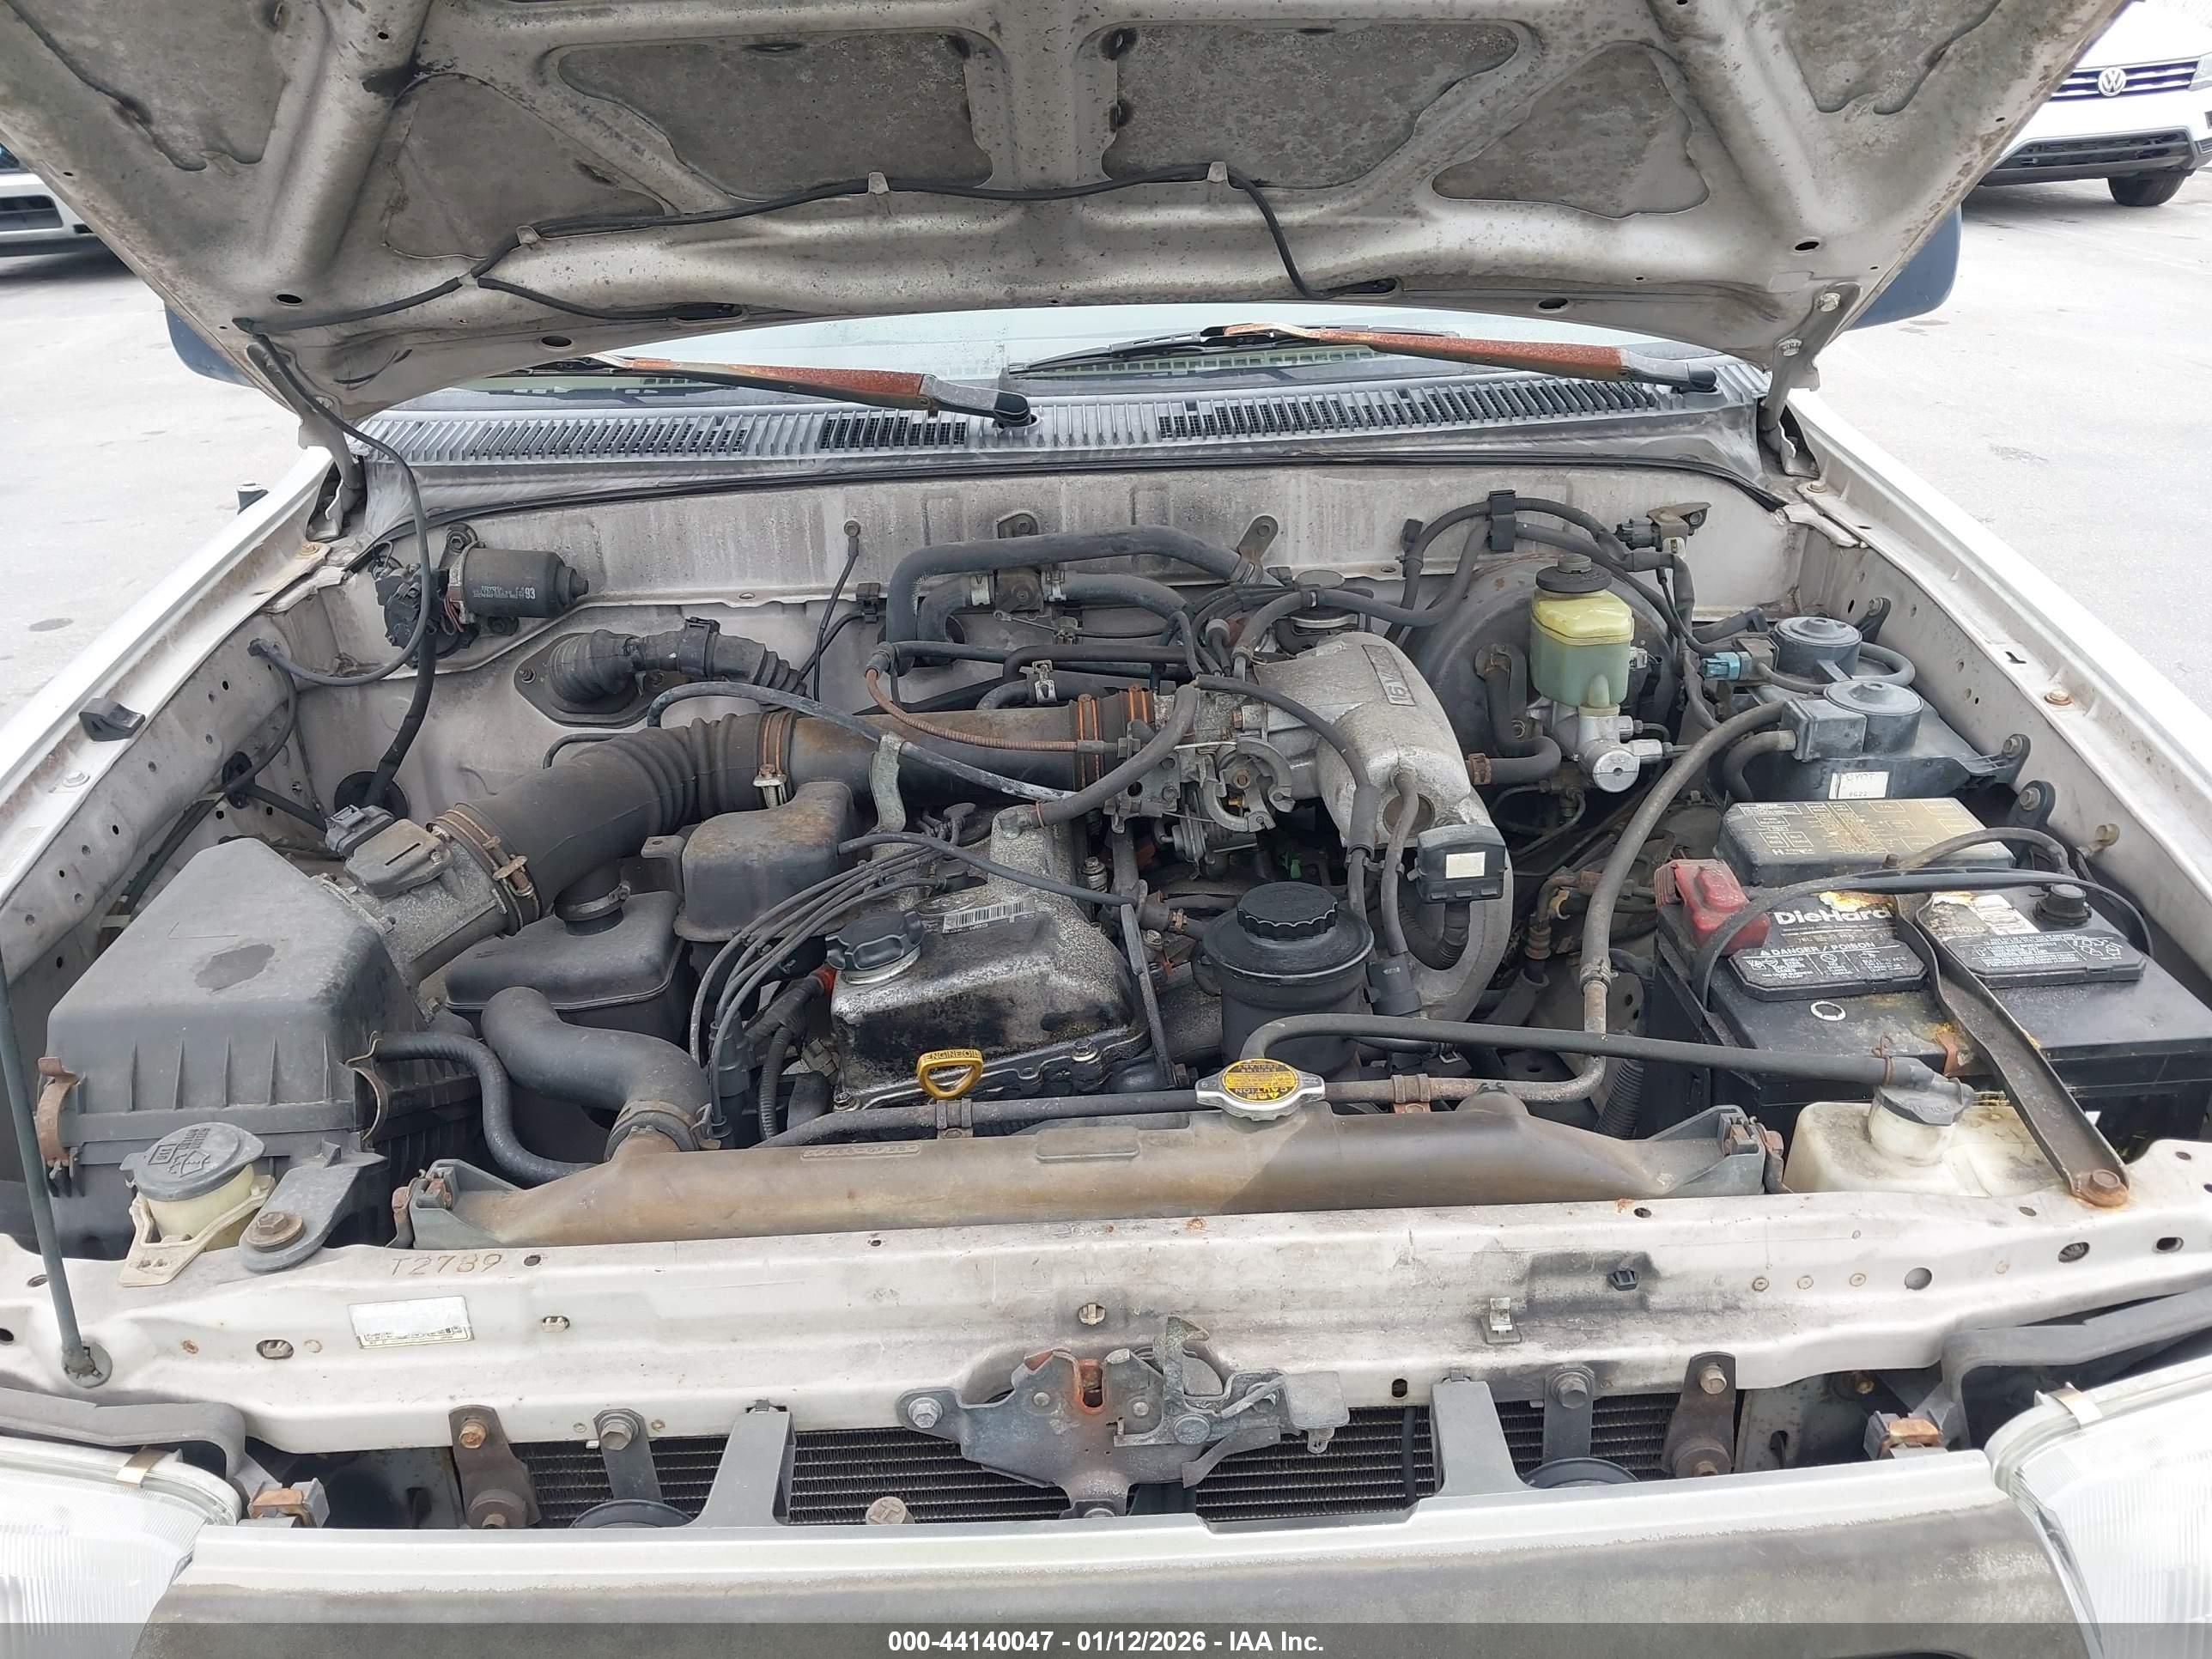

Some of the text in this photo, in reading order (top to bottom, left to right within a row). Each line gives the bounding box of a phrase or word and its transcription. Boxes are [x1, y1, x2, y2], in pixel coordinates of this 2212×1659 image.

[1773, 908, 1893, 926] DieHard
[1771, 945, 1820, 956] DANGER
[1831, 942, 1876, 951] POISON
[392, 1253, 503, 1277] T2789
